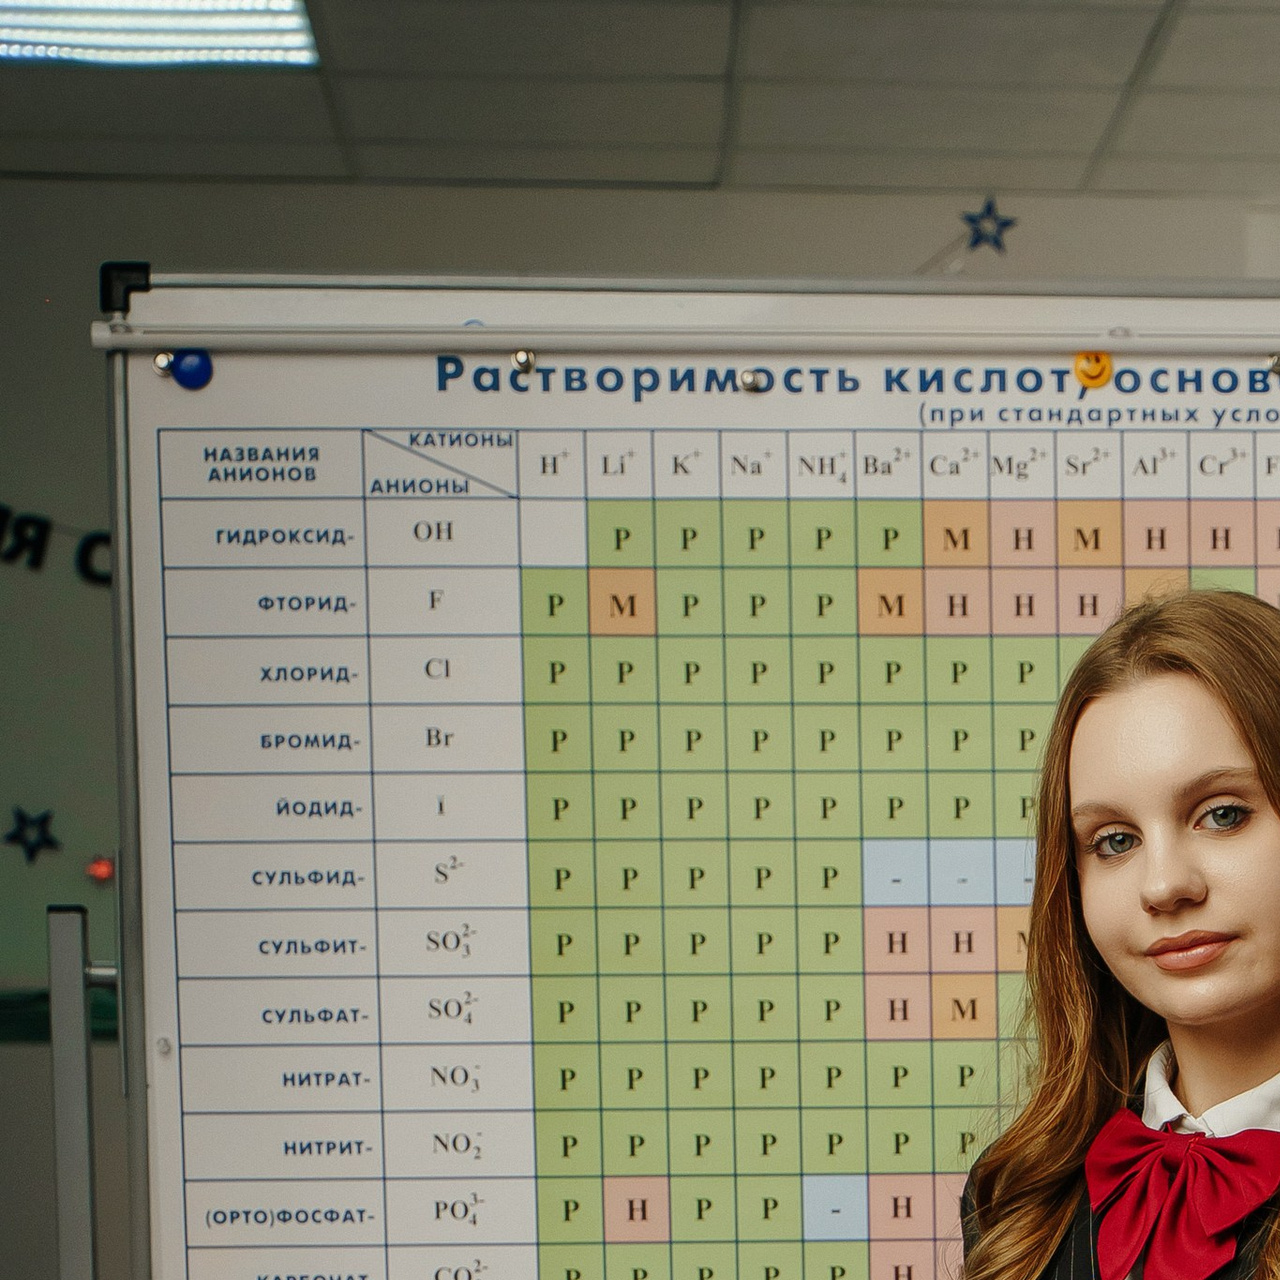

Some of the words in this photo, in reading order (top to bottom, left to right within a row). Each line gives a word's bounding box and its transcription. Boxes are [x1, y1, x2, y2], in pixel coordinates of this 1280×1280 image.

[920, 403, 983, 425] (при
[999, 408, 1198, 424] стандартных
[410, 433, 512, 447] КАТИОНЫ
[204, 447, 318, 462] НАЗВАНИЯ
[209, 467, 316, 482] АНИОНОВ
[371, 479, 469, 494] АНИОНЫ
[217, 529, 353, 546] ГИДРОКСИД-
[414, 522, 452, 540] OH
[258, 597, 355, 612] ФТОРИД-
[431, 591, 444, 609] F
[261, 667, 357, 683] ХЛОРИД-
[425, 659, 449, 677] Cl
[261, 735, 359, 750] БРОМИД-
[427, 729, 453, 746] Br
[277, 798, 361, 817] ЙОДИД-
[252, 871, 363, 886] СУЛЬФИД-
[259, 940, 365, 954] СУЛЬФИТ-
[262, 1009, 368, 1024] СУЛЬФАТ-
[283, 1073, 369, 1086] НИТРАТ-
[284, 1141, 371, 1155] НИТРИТ-
[206, 1210, 374, 1228] (ОРТО)ФОСФАТ-
